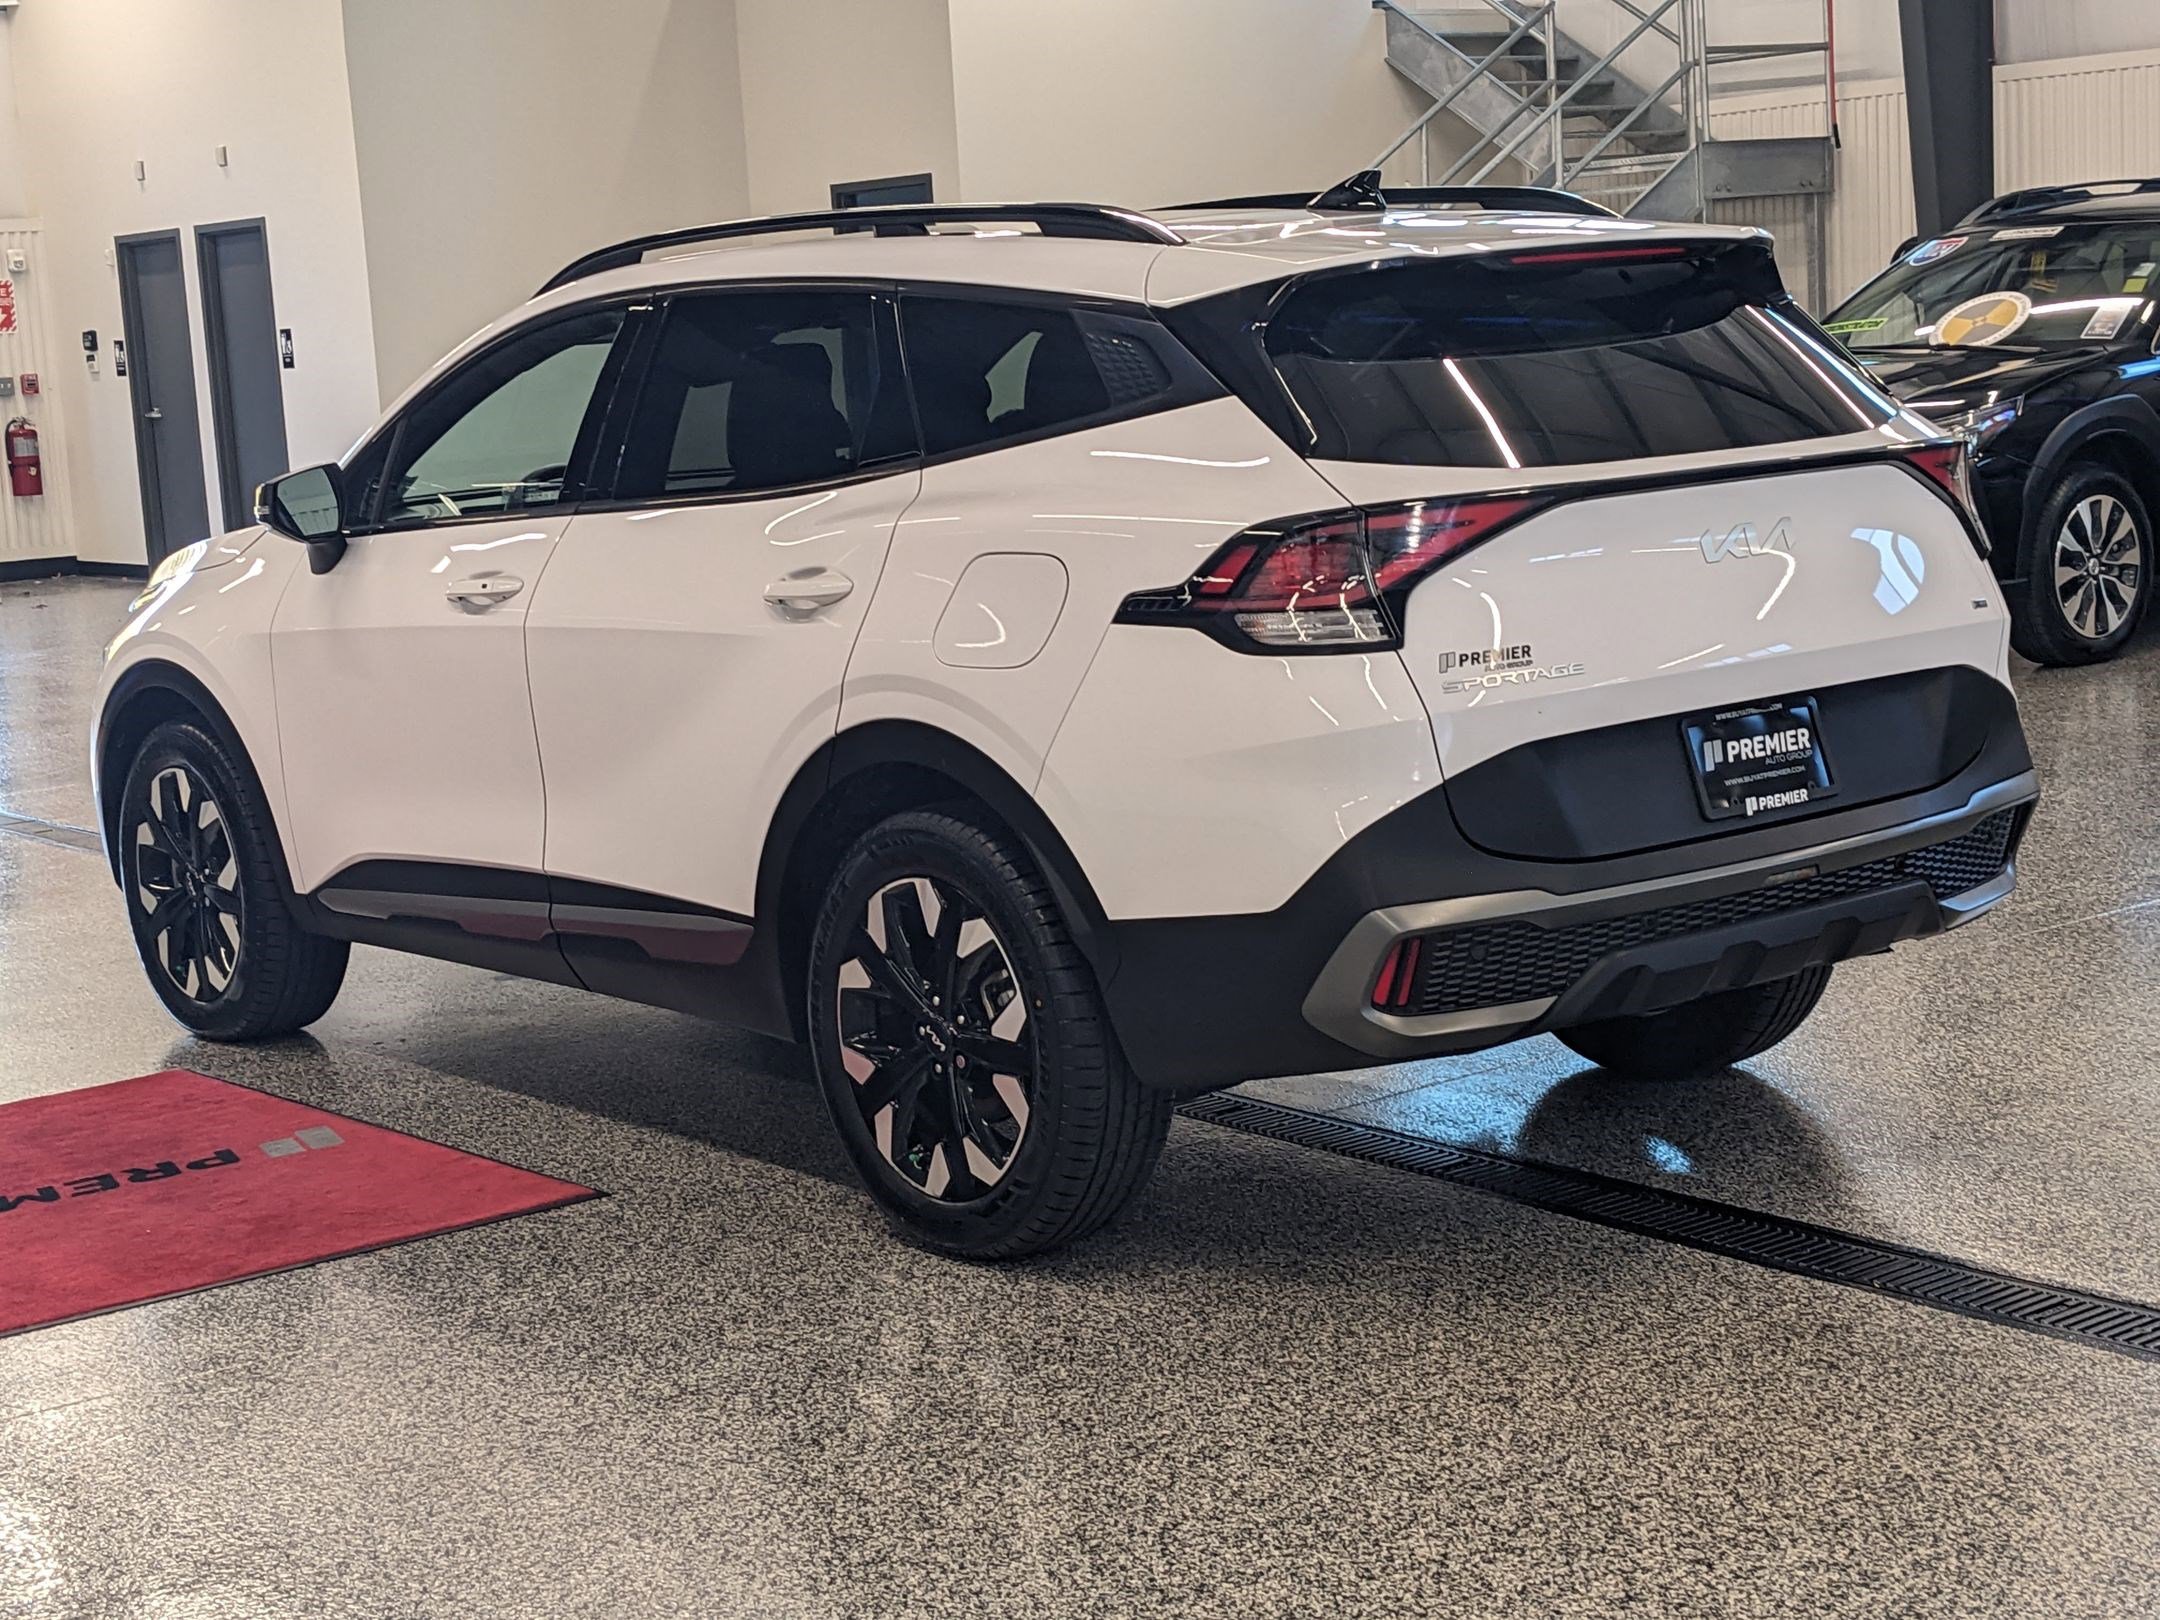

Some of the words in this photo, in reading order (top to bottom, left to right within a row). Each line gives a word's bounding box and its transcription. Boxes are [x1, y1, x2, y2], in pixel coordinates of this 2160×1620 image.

[1458, 644, 1532, 667] PREMIER
[1441, 663, 1585, 694] SPORTAGE
[1726, 727, 1811, 764] PREMIER
[1765, 753, 1787, 765] AUTO
[1786, 749, 1813, 762] GROUP
[1759, 788, 1809, 811] PREMIER
